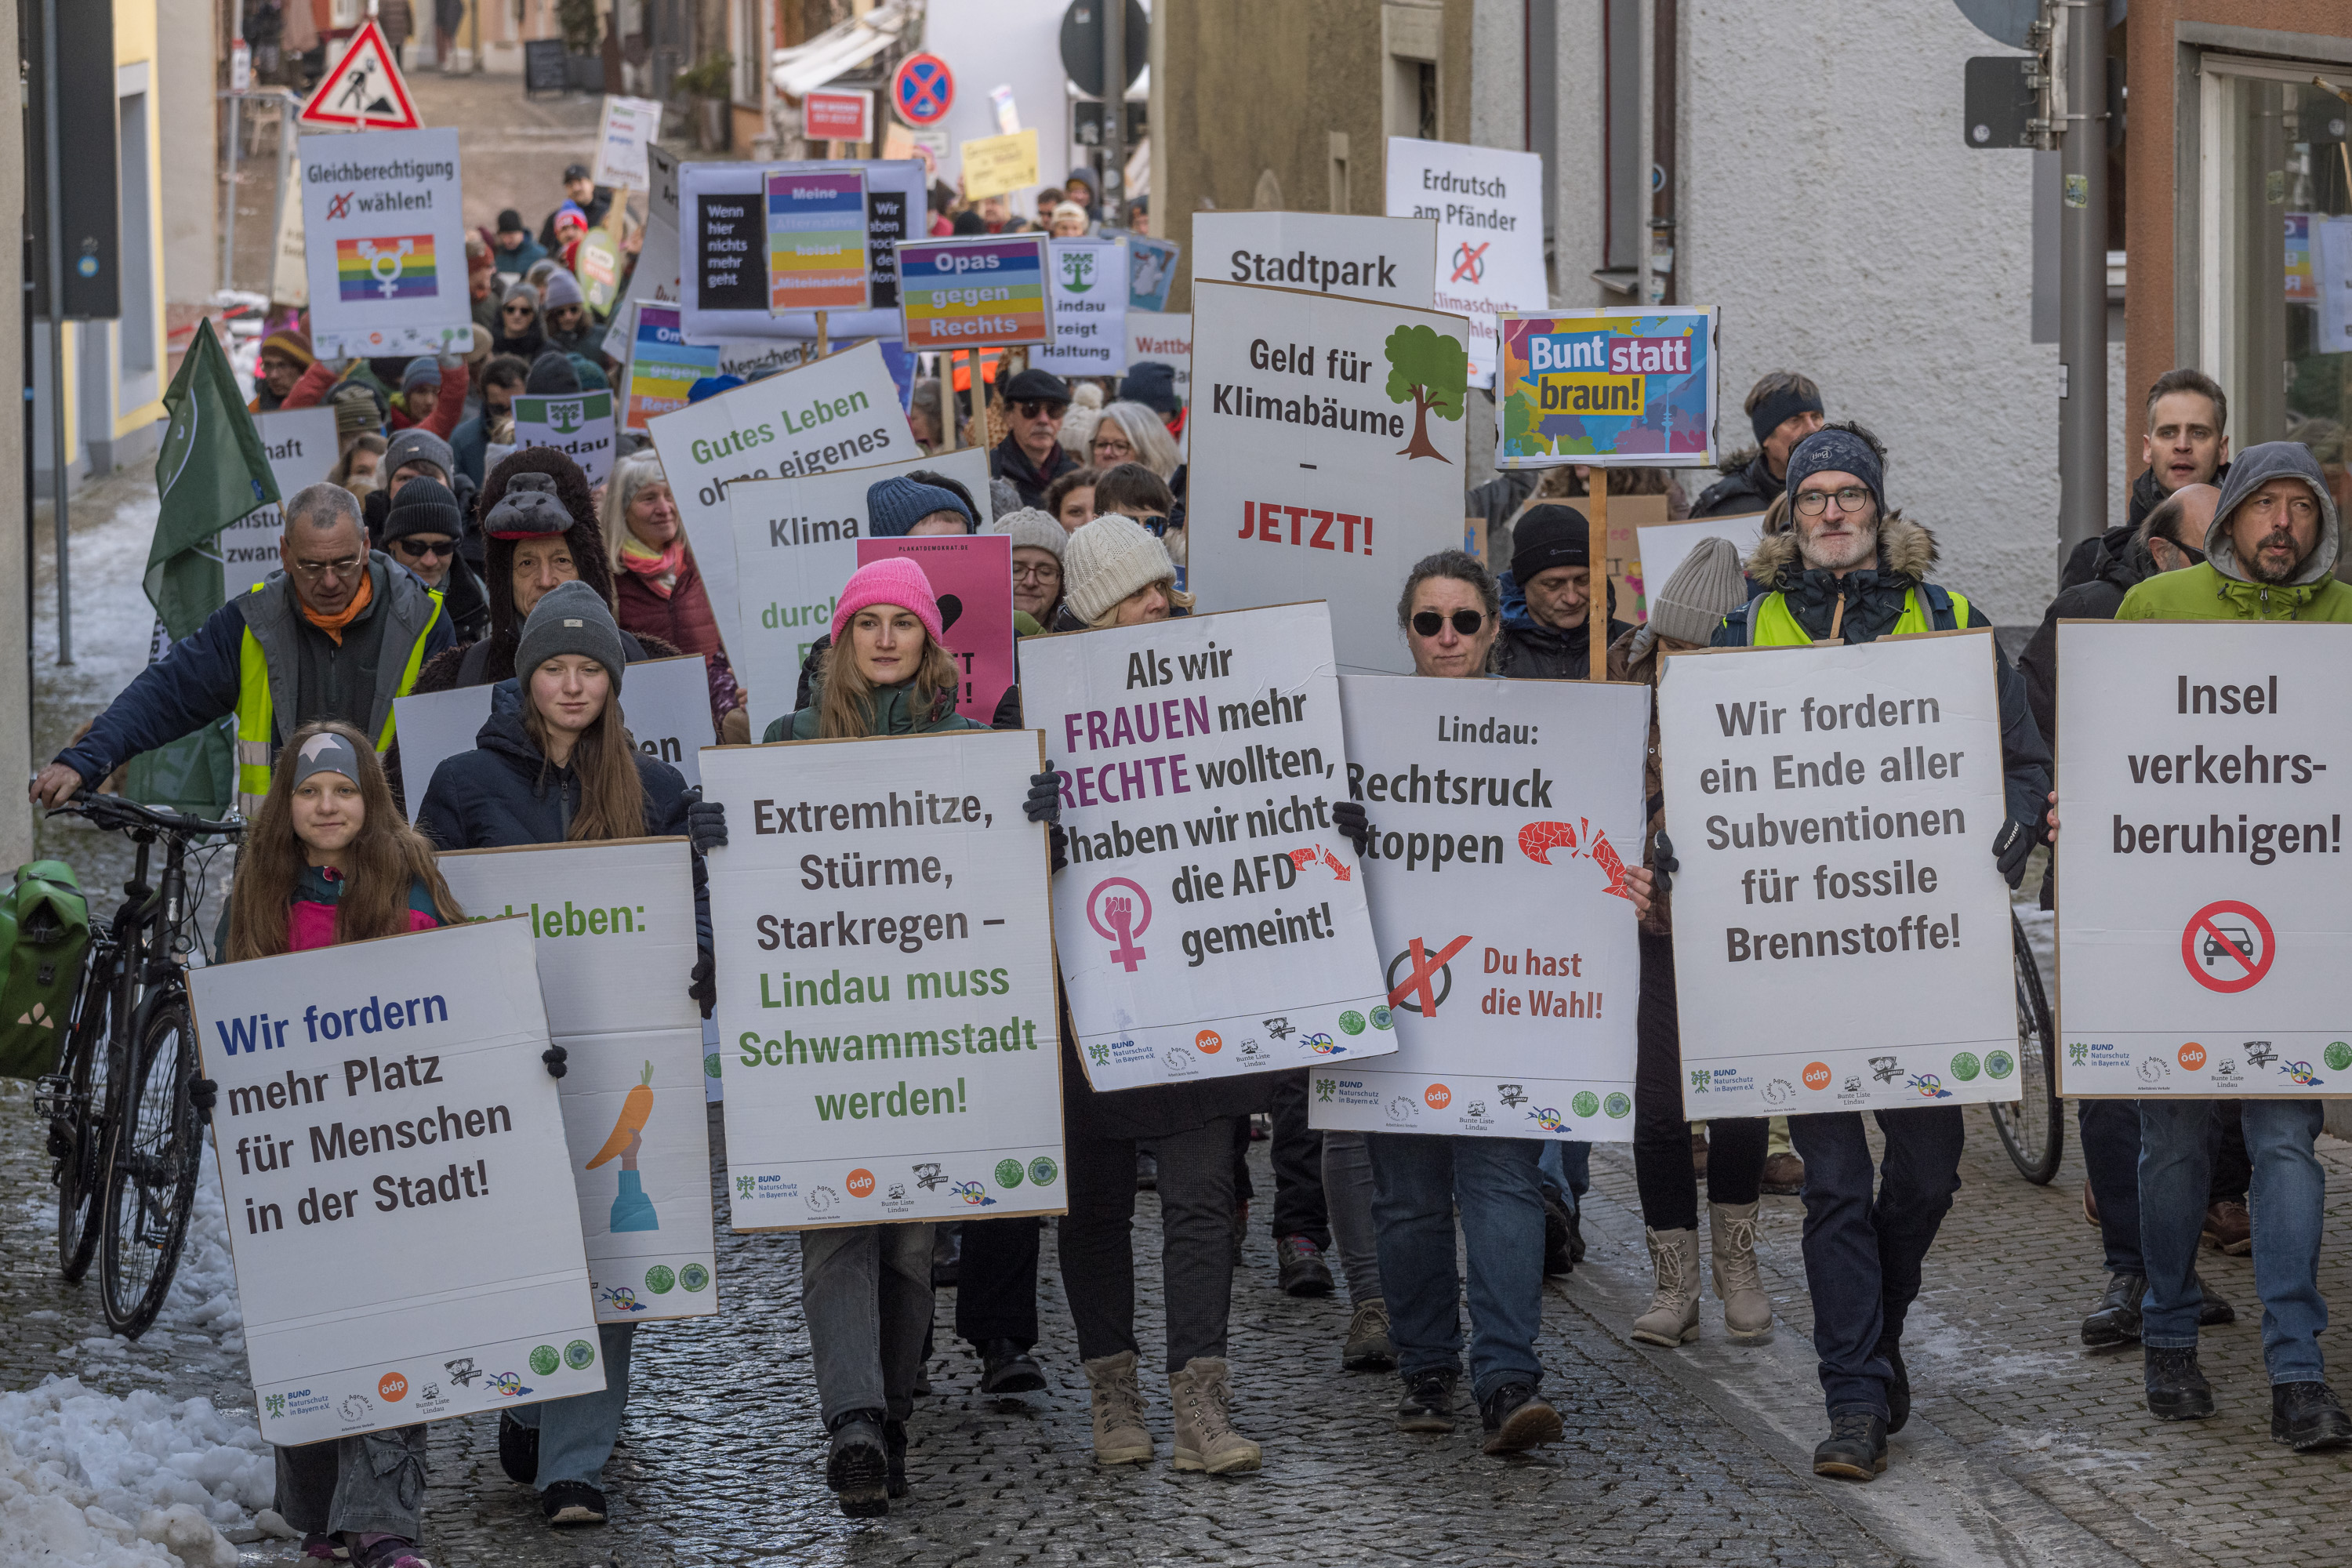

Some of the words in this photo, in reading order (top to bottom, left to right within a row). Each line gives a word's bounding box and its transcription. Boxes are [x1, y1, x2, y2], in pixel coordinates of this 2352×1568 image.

[307, 160, 453, 183] Gleichberechtigung
[1423, 168, 1506, 198] Erdrutsch
[358, 191, 432, 212] wählen!
[792, 187, 838, 201] Meine
[875, 201, 900, 216] Wir
[707, 205, 744, 219] Wenn
[869, 220, 900, 233] aben
[1414, 205, 1439, 222] am
[1446, 203, 1517, 231] Pfänder
[707, 222, 735, 235] hier
[707, 239, 748, 252] nichts
[707, 256, 743, 269] mehr
[935, 253, 1000, 274] Opas
[1231, 249, 1397, 291] Stadtpark
[707, 274, 739, 289] geht
[931, 287, 1011, 309] gegen
[1056, 299, 1105, 313] indau
[931, 316, 1018, 337] Rechts
[1057, 322, 1098, 338] zeigt
[1043, 345, 1110, 361] Haltung
[1250, 339, 1315, 377] Geld
[1327, 347, 1372, 383] für
[1531, 332, 1605, 370] Bunt
[1611, 337, 1689, 372] statt
[650, 365, 701, 380] gegen
[1539, 377, 1640, 410] braun!
[1213, 384, 1404, 437] Klimabäume
[691, 423, 775, 465] Gutes
[782, 390, 869, 435] Leben
[780, 428, 891, 478] eigenes
[770, 517, 859, 547] Klima
[1238, 500, 1374, 556] JETZT!
[1126, 651, 1174, 690] Als
[1178, 641, 1232, 682] wir
[2177, 674, 2278, 715] Insel
[1065, 695, 1210, 753] FRAUEN
[1218, 688, 1307, 732] mehr
[1716, 699, 1787, 737] Wir
[1800, 691, 1940, 733] fordern
[1438, 715, 1538, 745] Lindau:
[1057, 753, 1191, 809] RECHTE
[1196, 744, 1334, 789] wollten,
[1700, 759, 1758, 795] ein
[1774, 753, 1864, 789] Ende
[1881, 748, 1963, 784] aller
[2128, 743, 2327, 785] verkehrs-
[753, 789, 993, 835] Extremhitze,
[1069, 820, 1178, 863] haben
[1184, 806, 1239, 846] wir
[1247, 794, 1330, 838] nicht
[1706, 805, 1965, 852] Subventionen
[2004, 821, 2020, 851] ziener
[2114, 813, 2340, 866] beruhigen!
[1367, 824, 1504, 872] toppen
[800, 851, 953, 891] Stürme,
[1172, 864, 1224, 904] die
[1232, 853, 1297, 896] AFD
[1741, 869, 1799, 906] für
[1815, 858, 1938, 902] fossile
[757, 910, 968, 953] Starkregen
[1181, 902, 1334, 967] gemeint!
[1726, 912, 1961, 963] Brennstoffe!
[1483, 947, 1518, 976] Du
[1525, 946, 1582, 978] hast
[760, 968, 889, 1008] Lindau
[907, 967, 1010, 1000] muss
[1481, 986, 1522, 1015] die
[1528, 989, 1603, 1018] Wahl!
[216, 1014, 291, 1056] Wir
[303, 994, 448, 1043] fordern
[739, 1017, 1037, 1068] Schwammstadt
[1112, 1040, 1134, 1050] BUND
[1113, 1046, 1152, 1057] Naturschutz
[1199, 1036, 1219, 1047] ödp
[1123, 1055, 1145, 1065] Bayern
[2181, 1051, 2203, 1063] ödp
[228, 1069, 328, 1116] mehr
[345, 1054, 444, 1097] Platz
[1806, 1070, 1828, 1083] ödp
[814, 1077, 967, 1121] werden!
[1346, 1097, 1368, 1105] Bayern
[1428, 1091, 1448, 1102] ödp
[236, 1135, 291, 1175] für
[309, 1105, 513, 1163] Menschen
[245, 1196, 284, 1236] in
[297, 1186, 358, 1226] der
[372, 1159, 490, 1214] Stadt!
[766, 1191, 787, 1200] Bayern
[850, 1176, 872, 1189] ödp
[288, 1389, 310, 1399] BUND
[289, 1396, 328, 1408] Naturschutz
[382, 1380, 405, 1394] ödp
[297, 1406, 319, 1416] Bayern
[423, 1406, 445, 1414] Lindau
